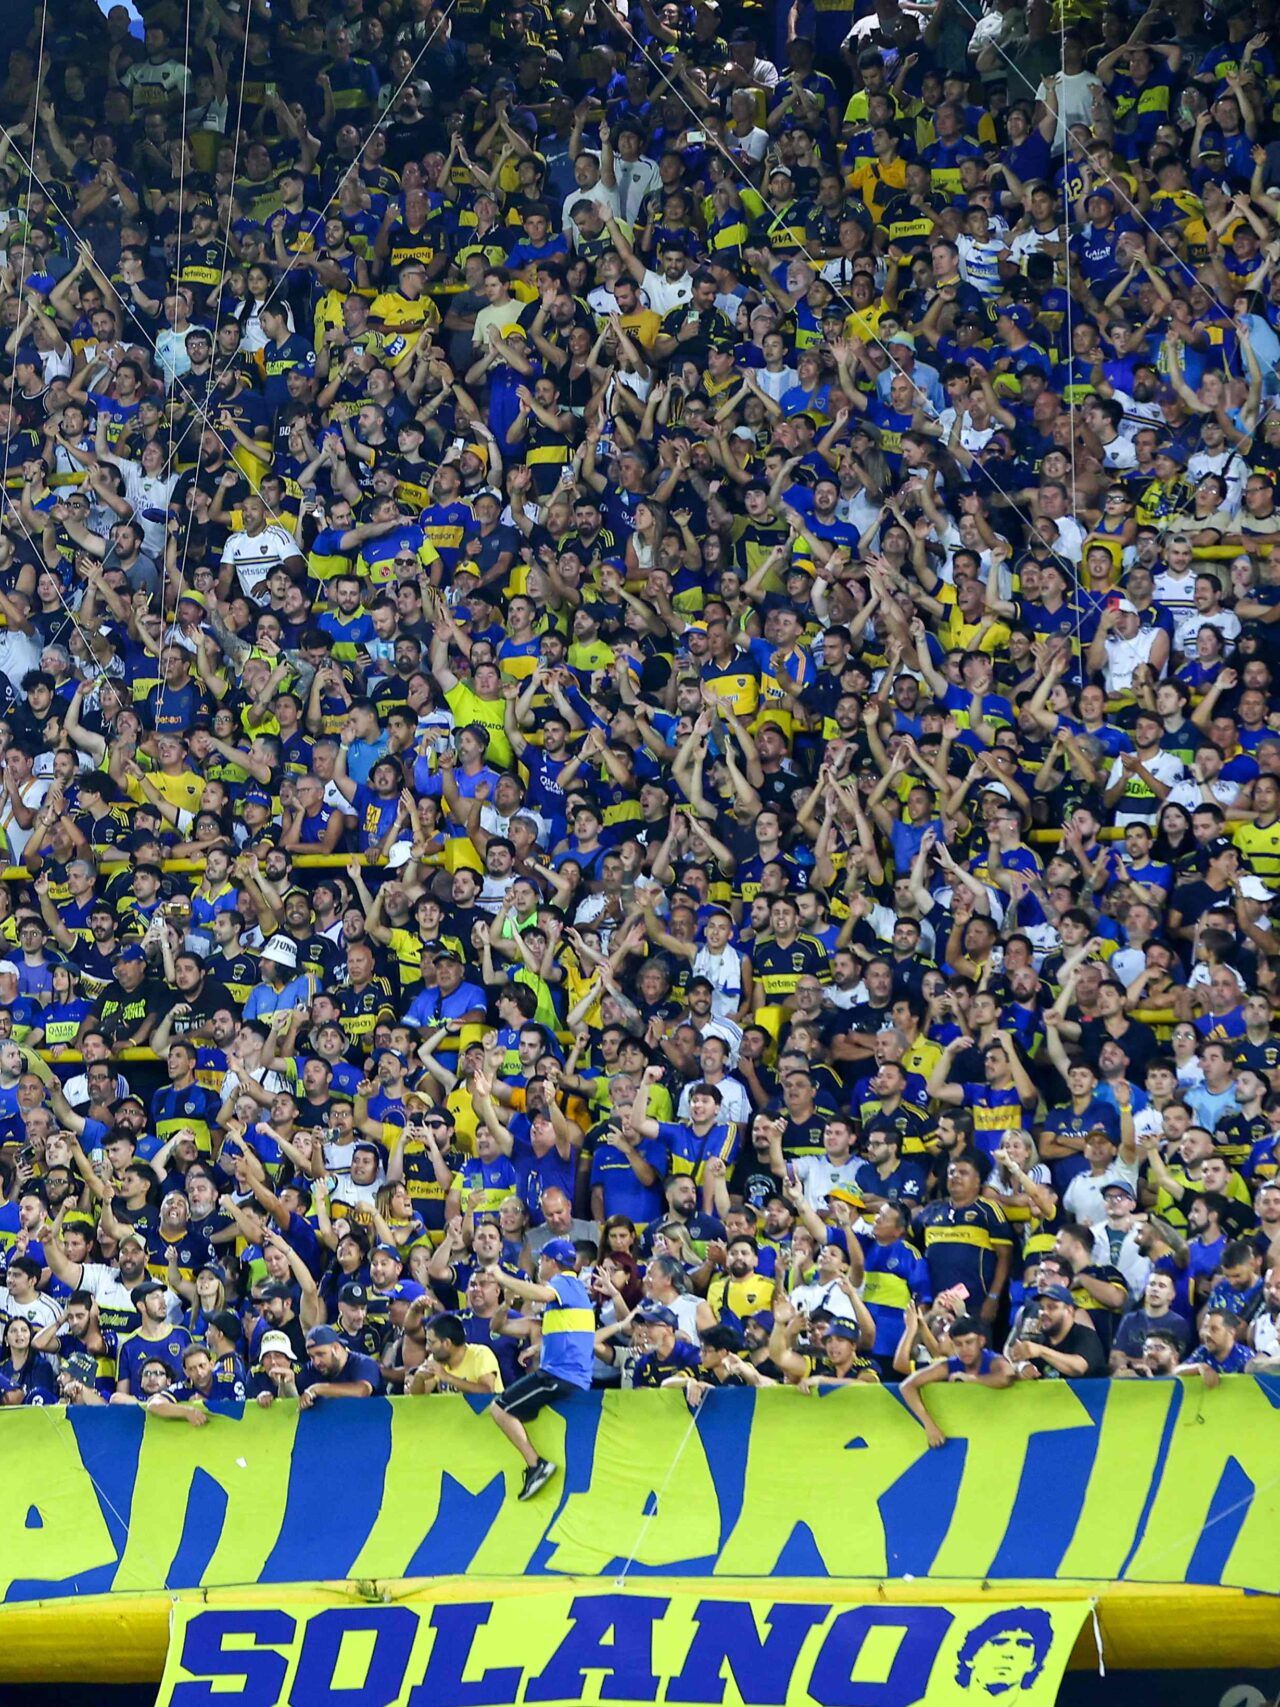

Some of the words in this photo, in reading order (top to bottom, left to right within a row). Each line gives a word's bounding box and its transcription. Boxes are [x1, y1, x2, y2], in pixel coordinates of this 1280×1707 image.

[48, 1025, 73, 1035] QATAR
[347, 1376, 1280, 1592] MARTIN
[170, 1594, 955, 1707] SOLANO
